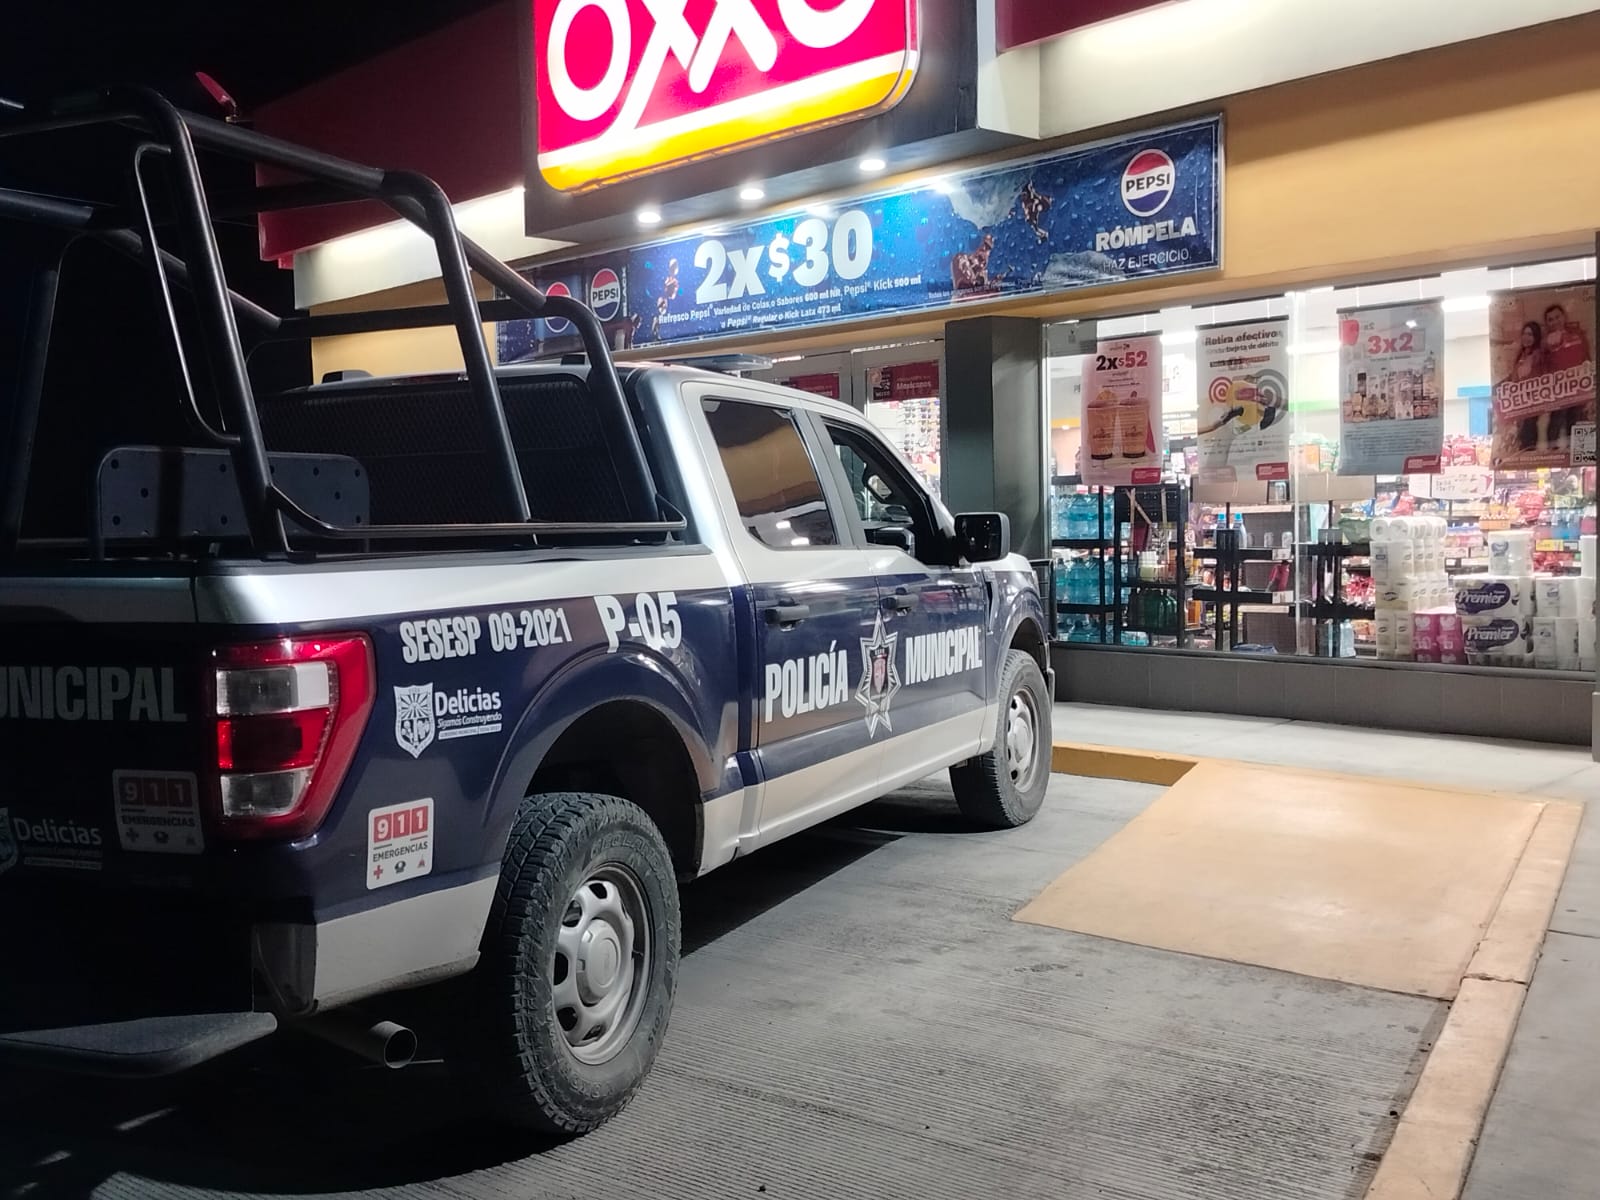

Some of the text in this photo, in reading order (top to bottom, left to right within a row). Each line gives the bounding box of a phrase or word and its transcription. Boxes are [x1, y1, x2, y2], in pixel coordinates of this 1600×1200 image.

[1125, 173, 1171, 193] PEPSI
[1096, 216, 1197, 252] RÓMPELA
[1103, 259, 1125, 273] HAZ
[592, 287, 619, 302] PEPSI
[659, 312, 689, 325] Refresco
[714, 305, 742, 317] Variedad
[743, 303, 751, 313] de
[777, 295, 803, 307] Sabores
[873, 279, 894, 291] Kick
[910, 274, 921, 286] ml
[752, 312, 777, 325] Regular
[784, 310, 800, 320] Kick
[801, 308, 816, 318] Lata
[1205, 330, 1277, 347] Retira efectivo
[1226, 344, 1248, 353] tarjeta
[1248, 342, 1257, 350] de
[1367, 332, 1413, 355] 3x2
[1501, 392, 1529, 410] DEL
[1460, 590, 1505, 604] Premier
[594, 591, 683, 653] P-05
[399, 607, 573, 664] SESESP 09-2021
[1467, 627, 1513, 641] Premier
[765, 625, 983, 723] POLICÍA MUNICIPAL
[435, 686, 502, 717] Delicias
[125, 781, 184, 803] 911
[13, 816, 103, 846] Delicias
[121, 814, 196, 828] EMERGENCIAS
[377, 809, 424, 840] 911
[372, 841, 429, 863] EMERGENCIAS
